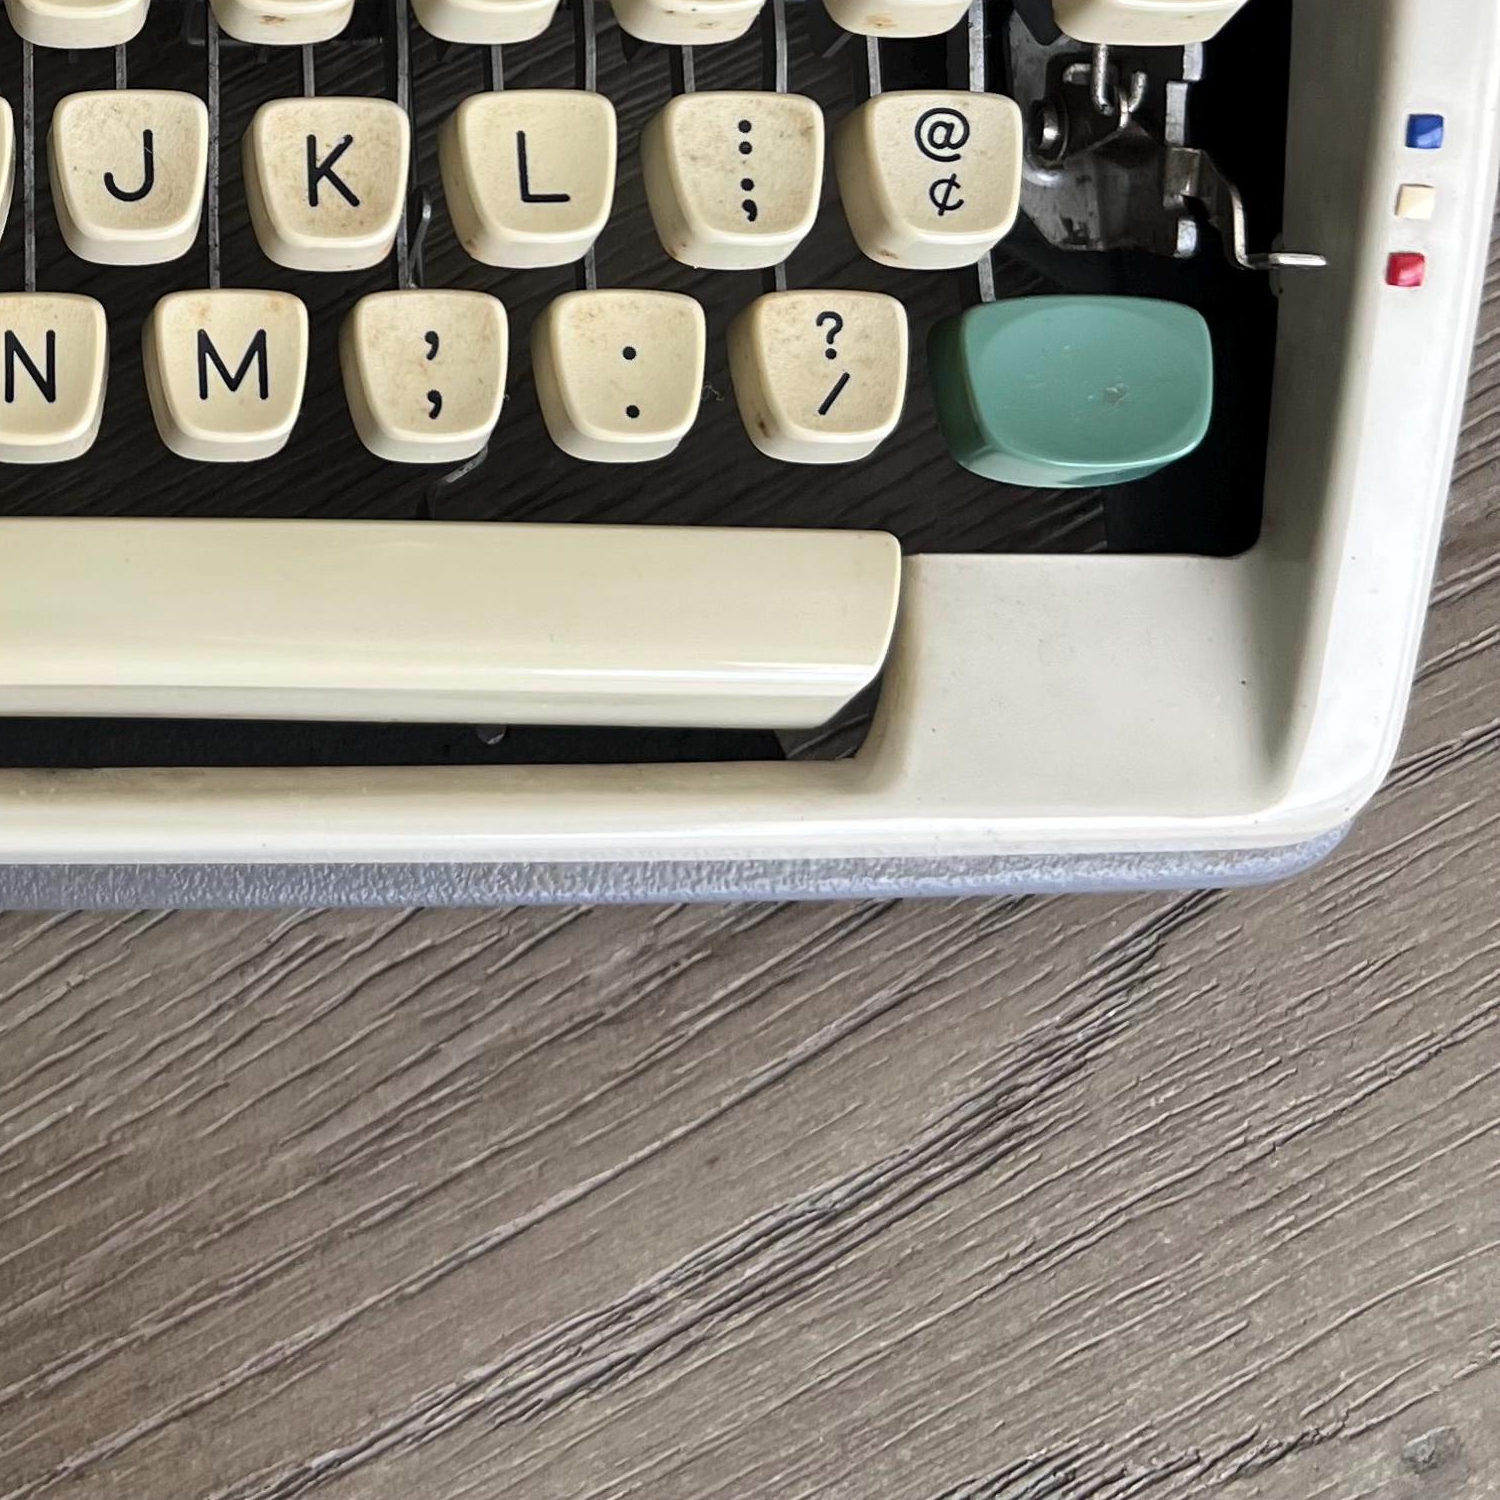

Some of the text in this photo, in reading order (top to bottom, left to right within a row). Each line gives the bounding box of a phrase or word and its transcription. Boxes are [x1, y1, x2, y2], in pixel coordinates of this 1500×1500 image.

[104, 129, 154, 202] J
[307, 135, 360, 207] K
[517, 131, 570, 203] L
[915, 108, 970, 162] @
[5, 330, 56, 403] N
[198, 329, 268, 400] M
[816, 312, 843, 359] ?
